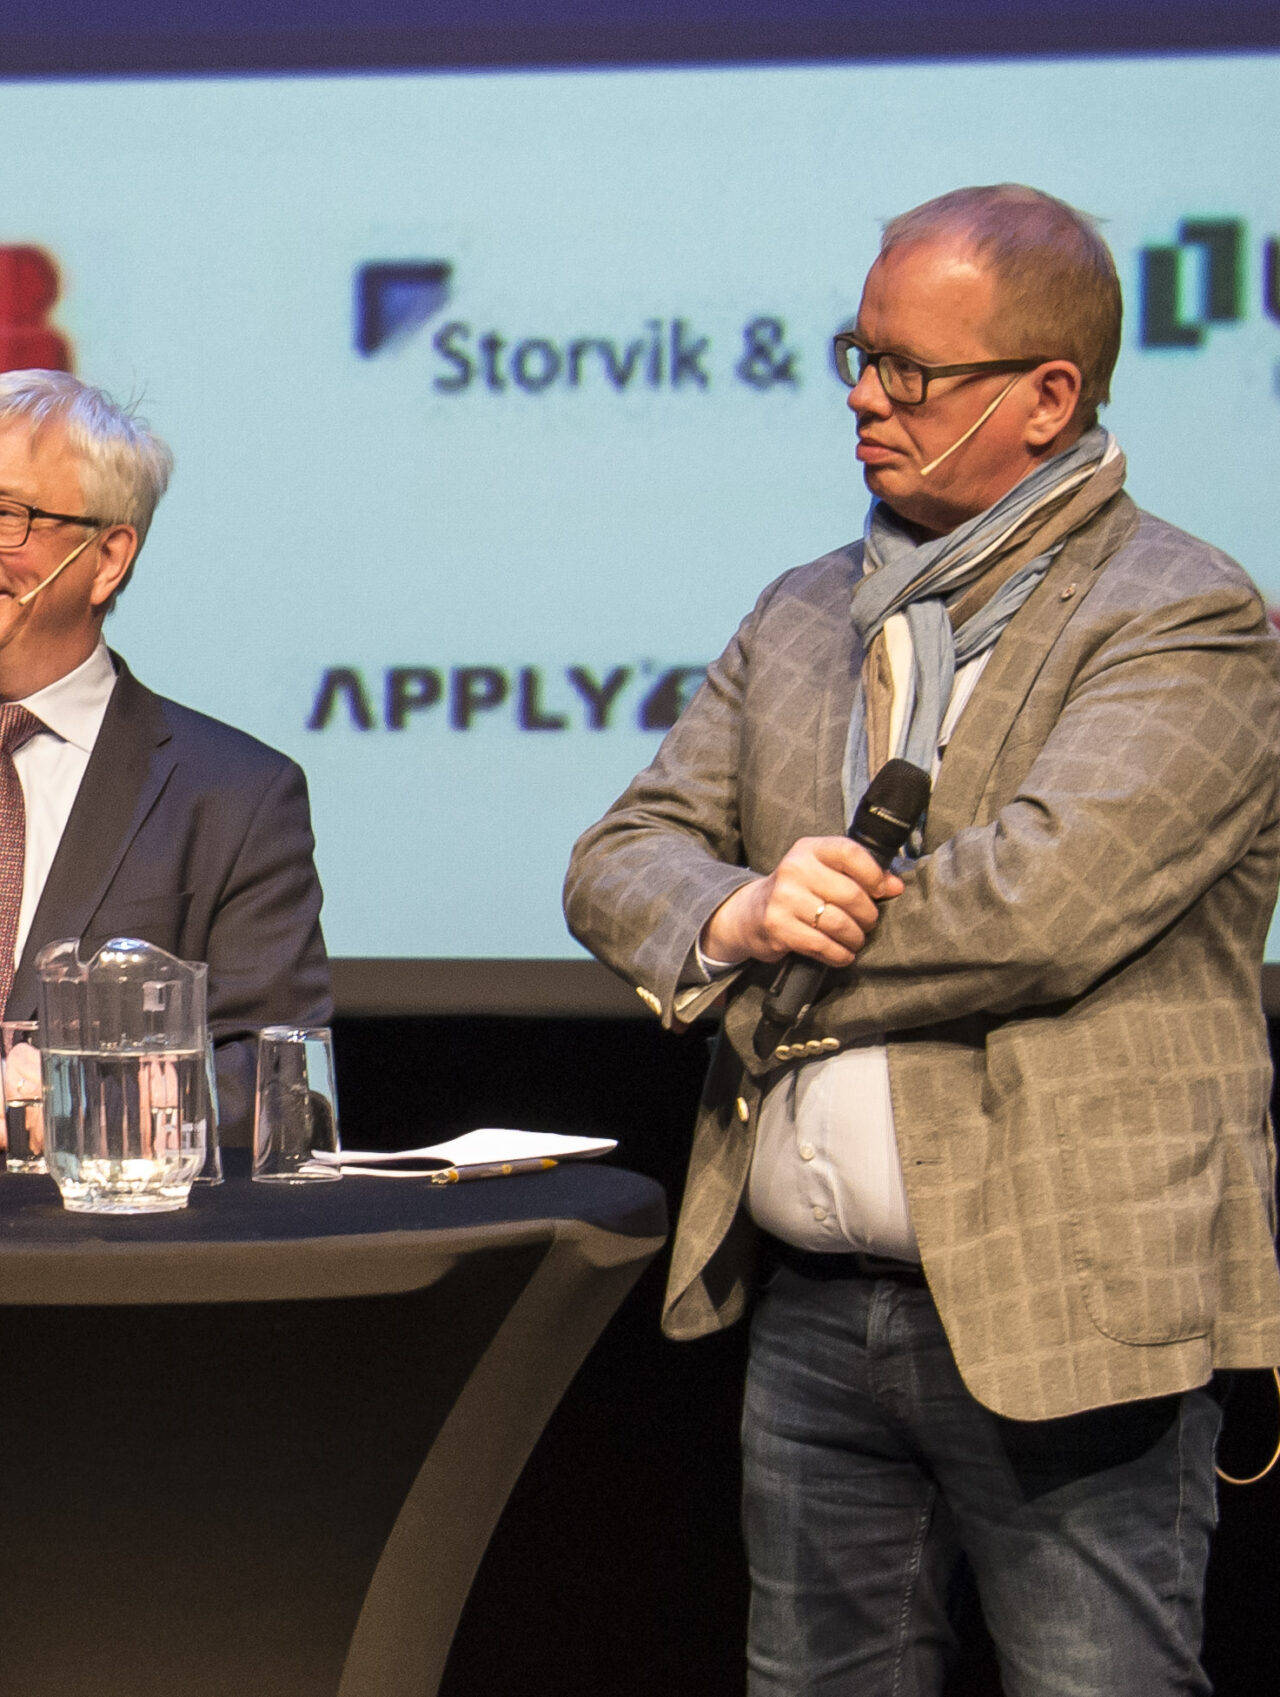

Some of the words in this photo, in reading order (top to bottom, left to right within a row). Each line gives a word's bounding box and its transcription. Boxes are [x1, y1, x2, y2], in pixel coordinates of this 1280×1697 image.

[432, 318, 708, 392] Storvik
[735, 316, 799, 389] &
[307, 665, 631, 731] APPLY
